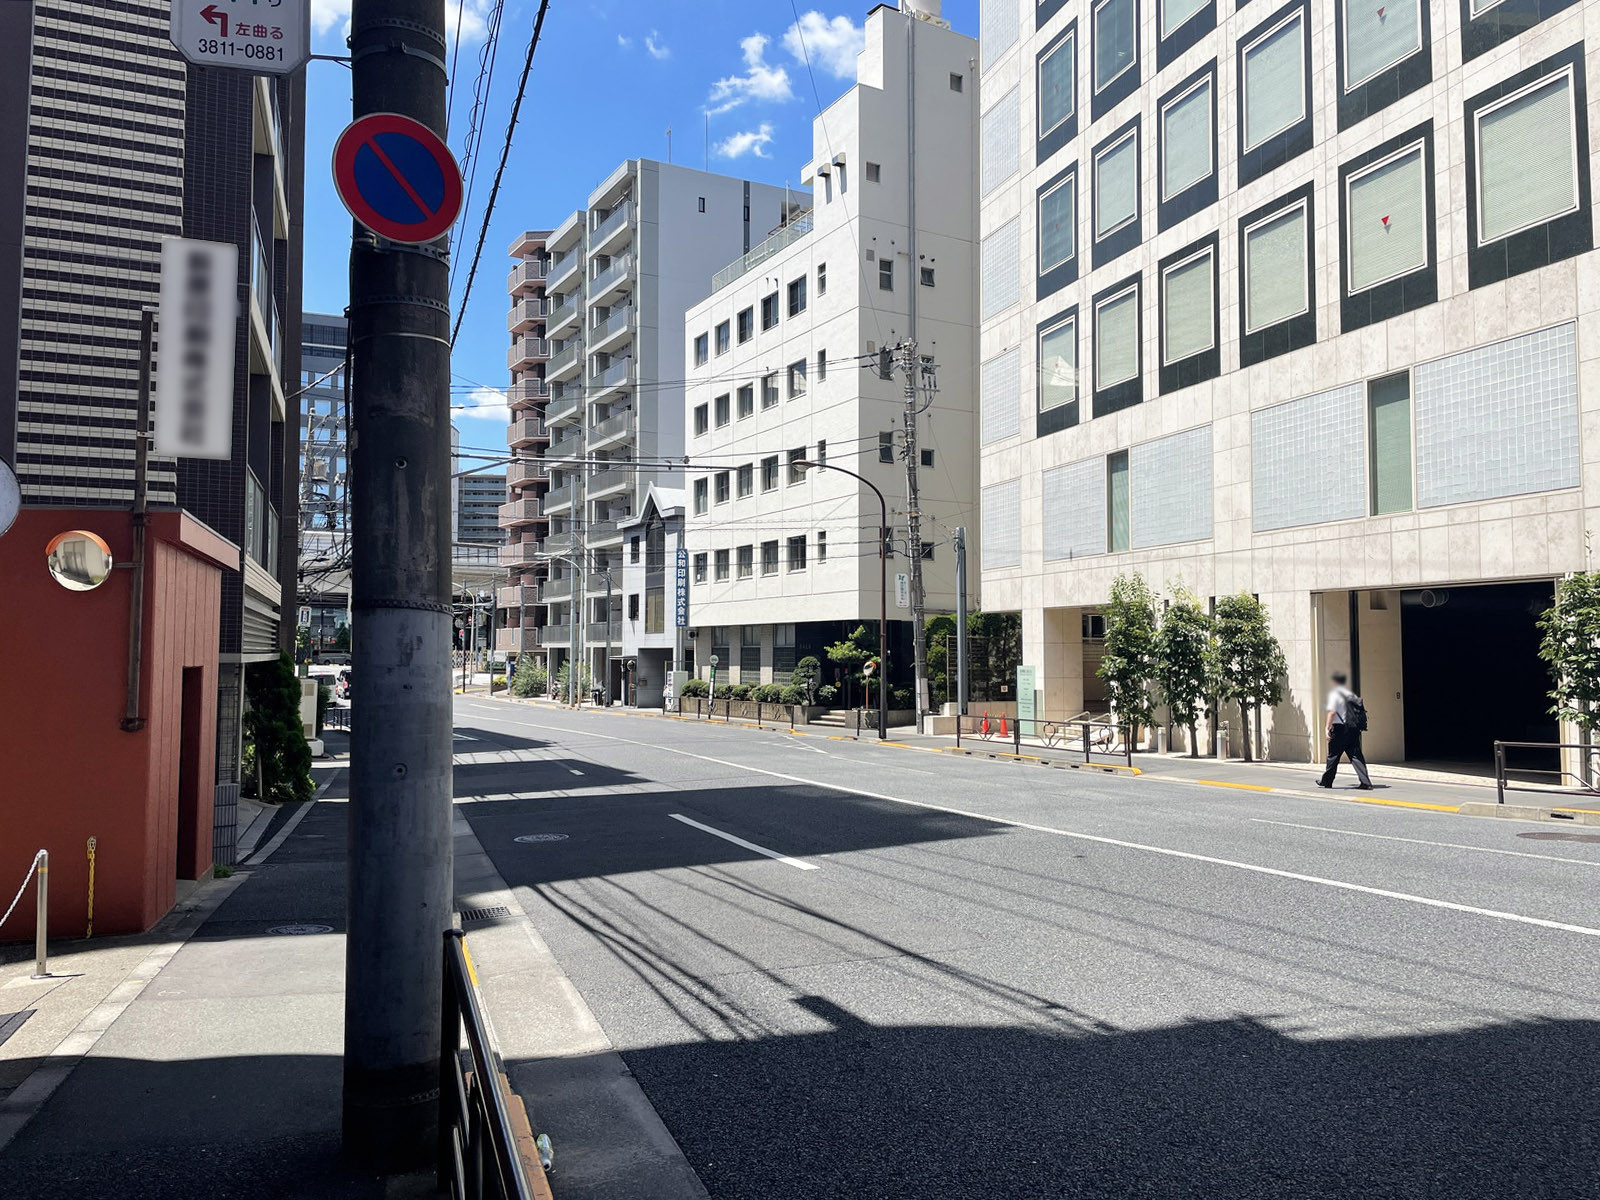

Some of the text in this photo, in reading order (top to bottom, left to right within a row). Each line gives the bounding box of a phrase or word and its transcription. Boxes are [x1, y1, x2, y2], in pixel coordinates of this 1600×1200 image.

[235, 22, 284, 40] 左曲る
[198, 39, 283, 61] 3811-0881
[677, 550, 687, 626] 公和印刷株式会社
